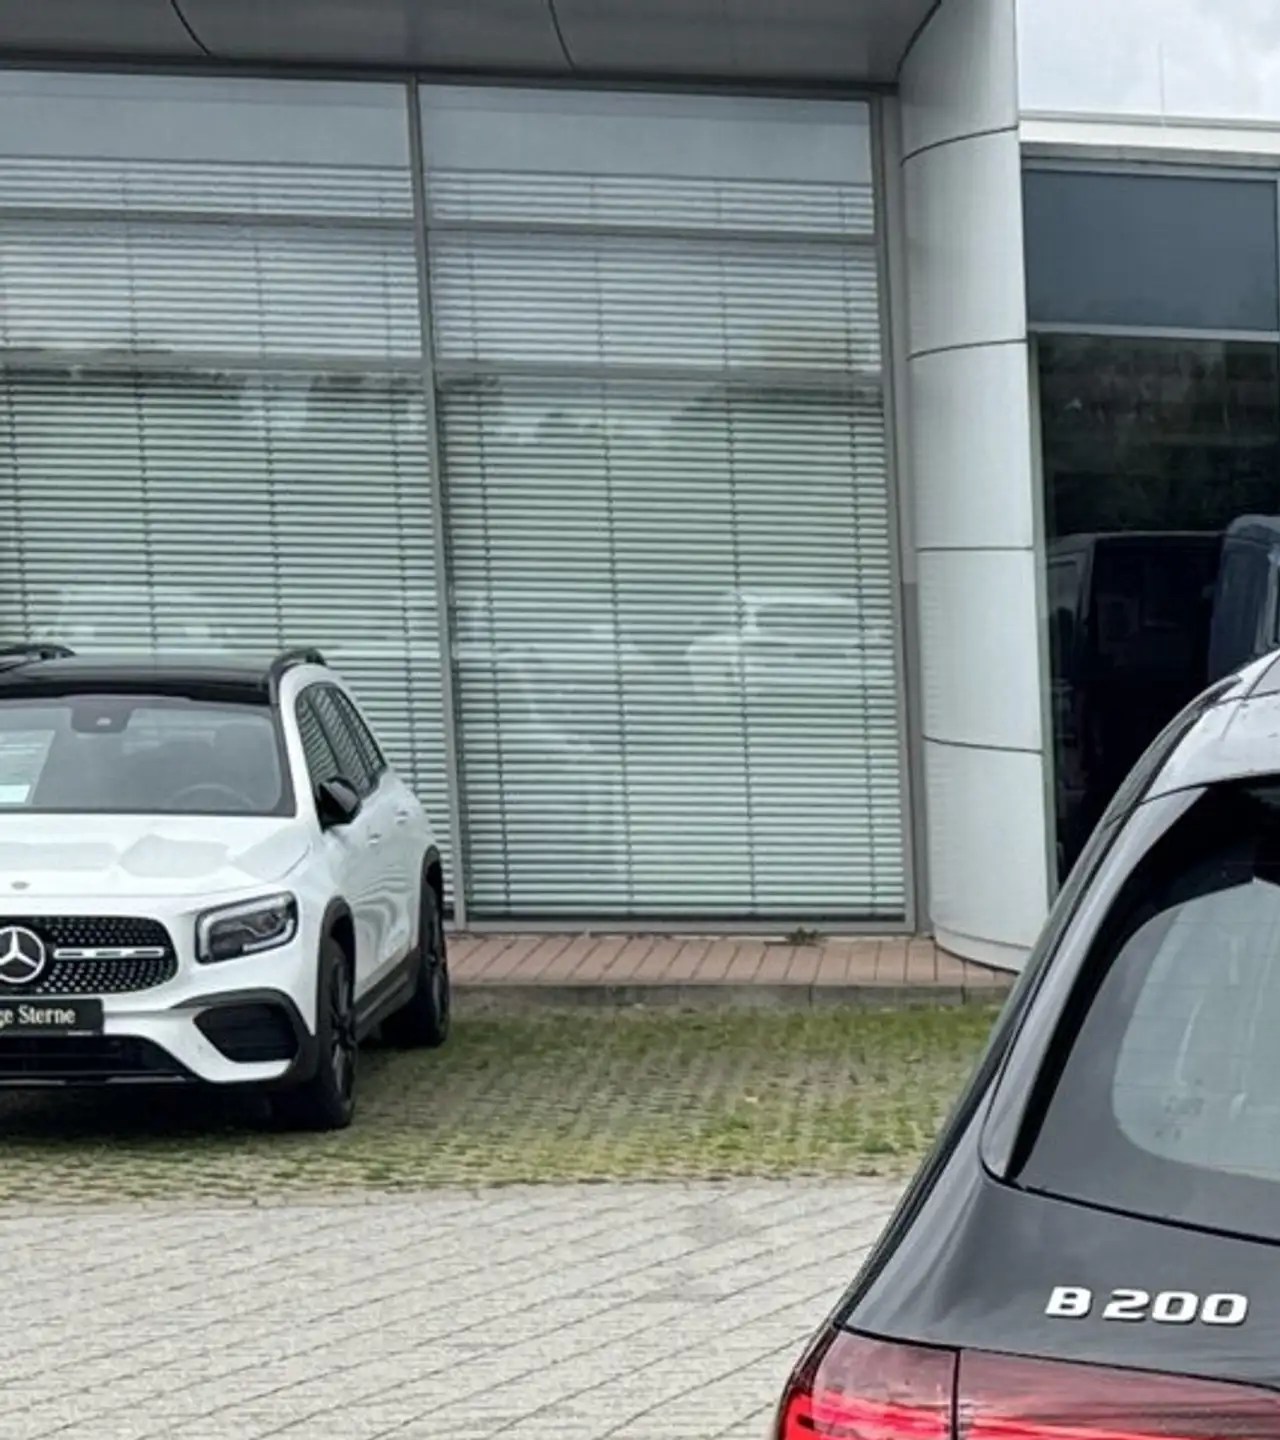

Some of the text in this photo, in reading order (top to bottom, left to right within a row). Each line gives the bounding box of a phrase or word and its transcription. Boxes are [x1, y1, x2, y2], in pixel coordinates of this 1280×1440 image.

[18, 1004, 76, 1025] Sterne
[1044, 1286, 1249, 1326] B 200
